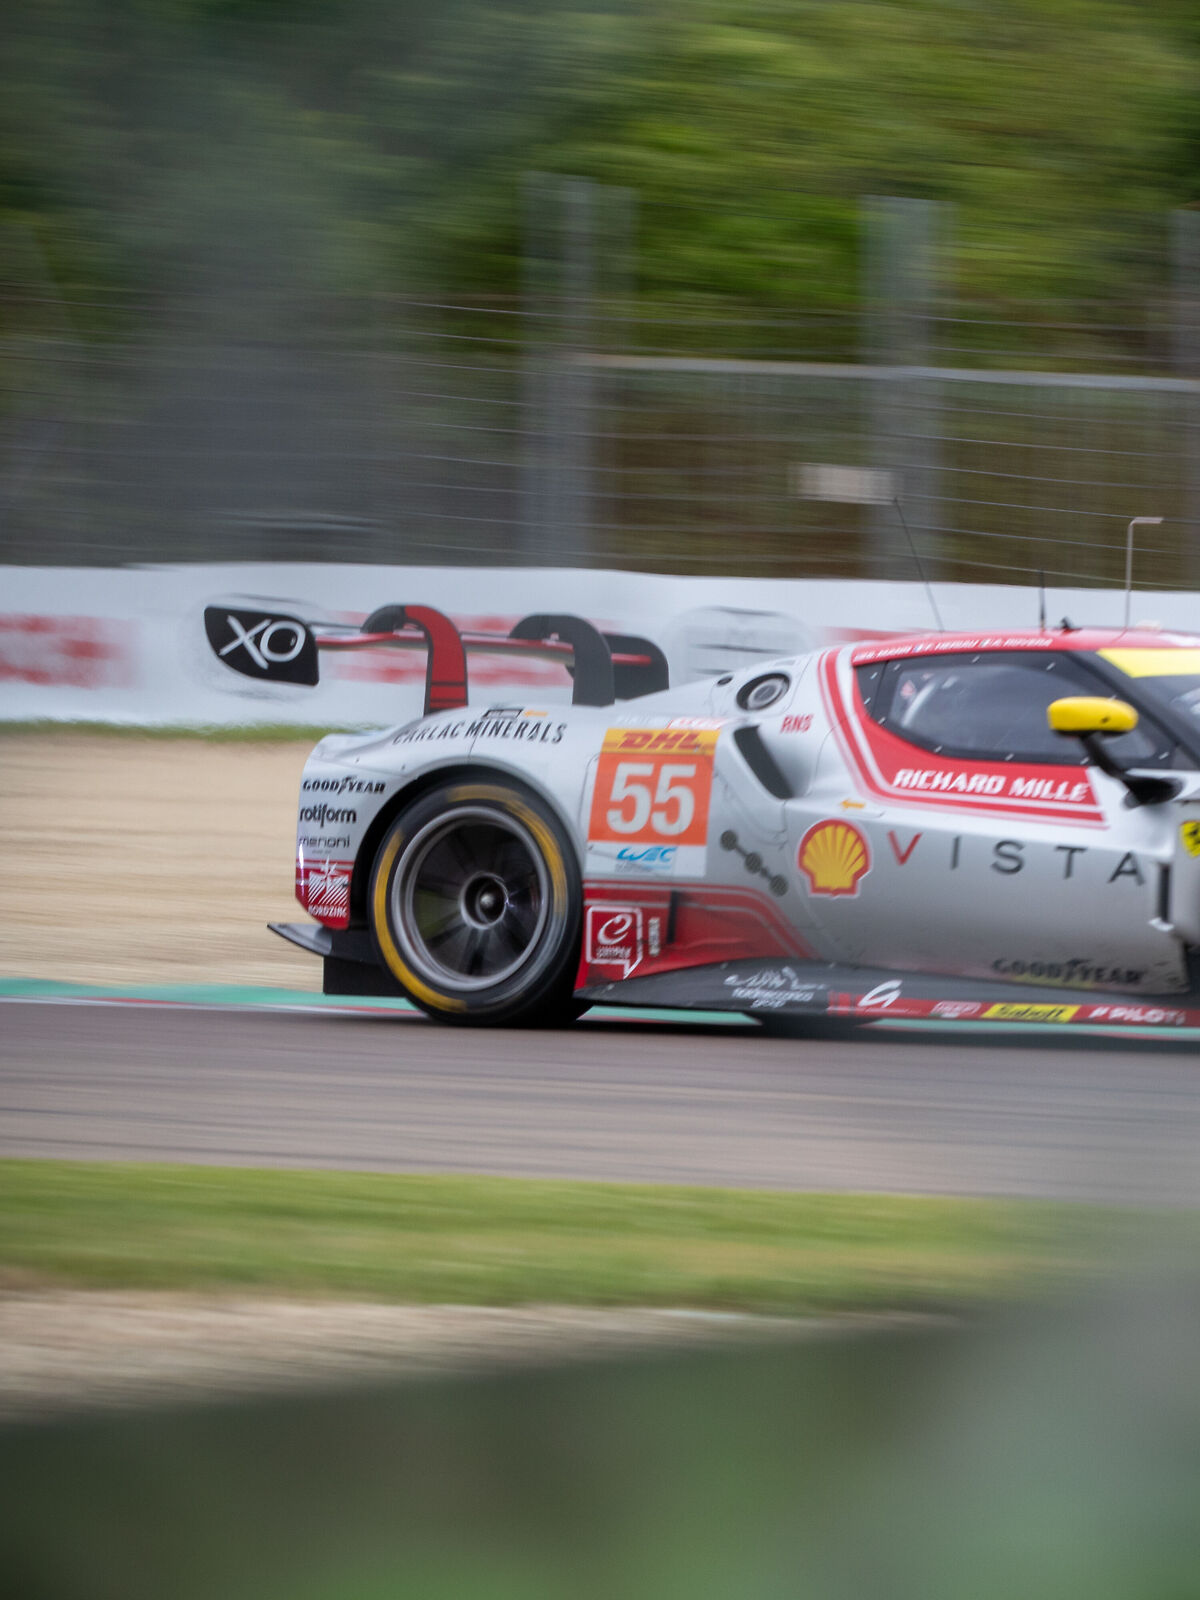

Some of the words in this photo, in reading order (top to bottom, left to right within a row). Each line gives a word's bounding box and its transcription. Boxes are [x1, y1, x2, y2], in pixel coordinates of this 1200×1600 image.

[219, 615, 306, 670] XO
[464, 707, 568, 745] MINERALS
[617, 731, 702, 751] DHL
[302, 775, 386, 796] GOODYEAR
[606, 761, 697, 837] 55
[892, 768, 1007, 795] RICHARD
[1007, 777, 1091, 803] MILLE
[299, 802, 357, 829] rotiform
[887, 829, 1146, 887] VISTA
[991, 957, 1148, 985] GOODYEAR
